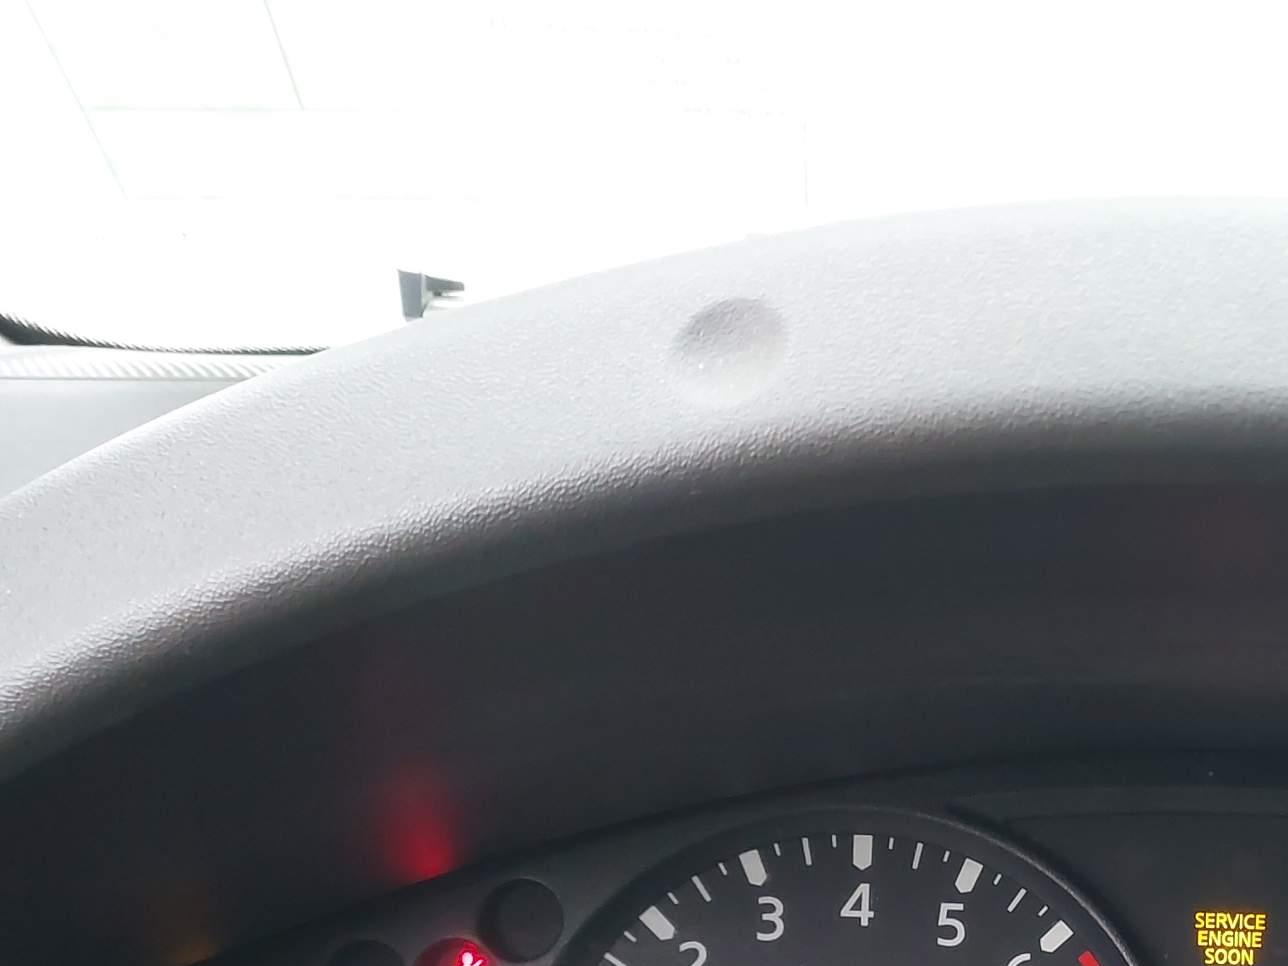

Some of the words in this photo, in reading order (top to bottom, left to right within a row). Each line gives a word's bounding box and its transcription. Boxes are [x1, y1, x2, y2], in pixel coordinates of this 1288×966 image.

[756, 896, 785, 942] 3
[840, 883, 875, 927] 4
[936, 902, 966, 947] 5
[1194, 912, 1266, 930] SERVICE
[1197, 930, 1262, 948] ENGINE
[1204, 947, 1254, 966] SOON
